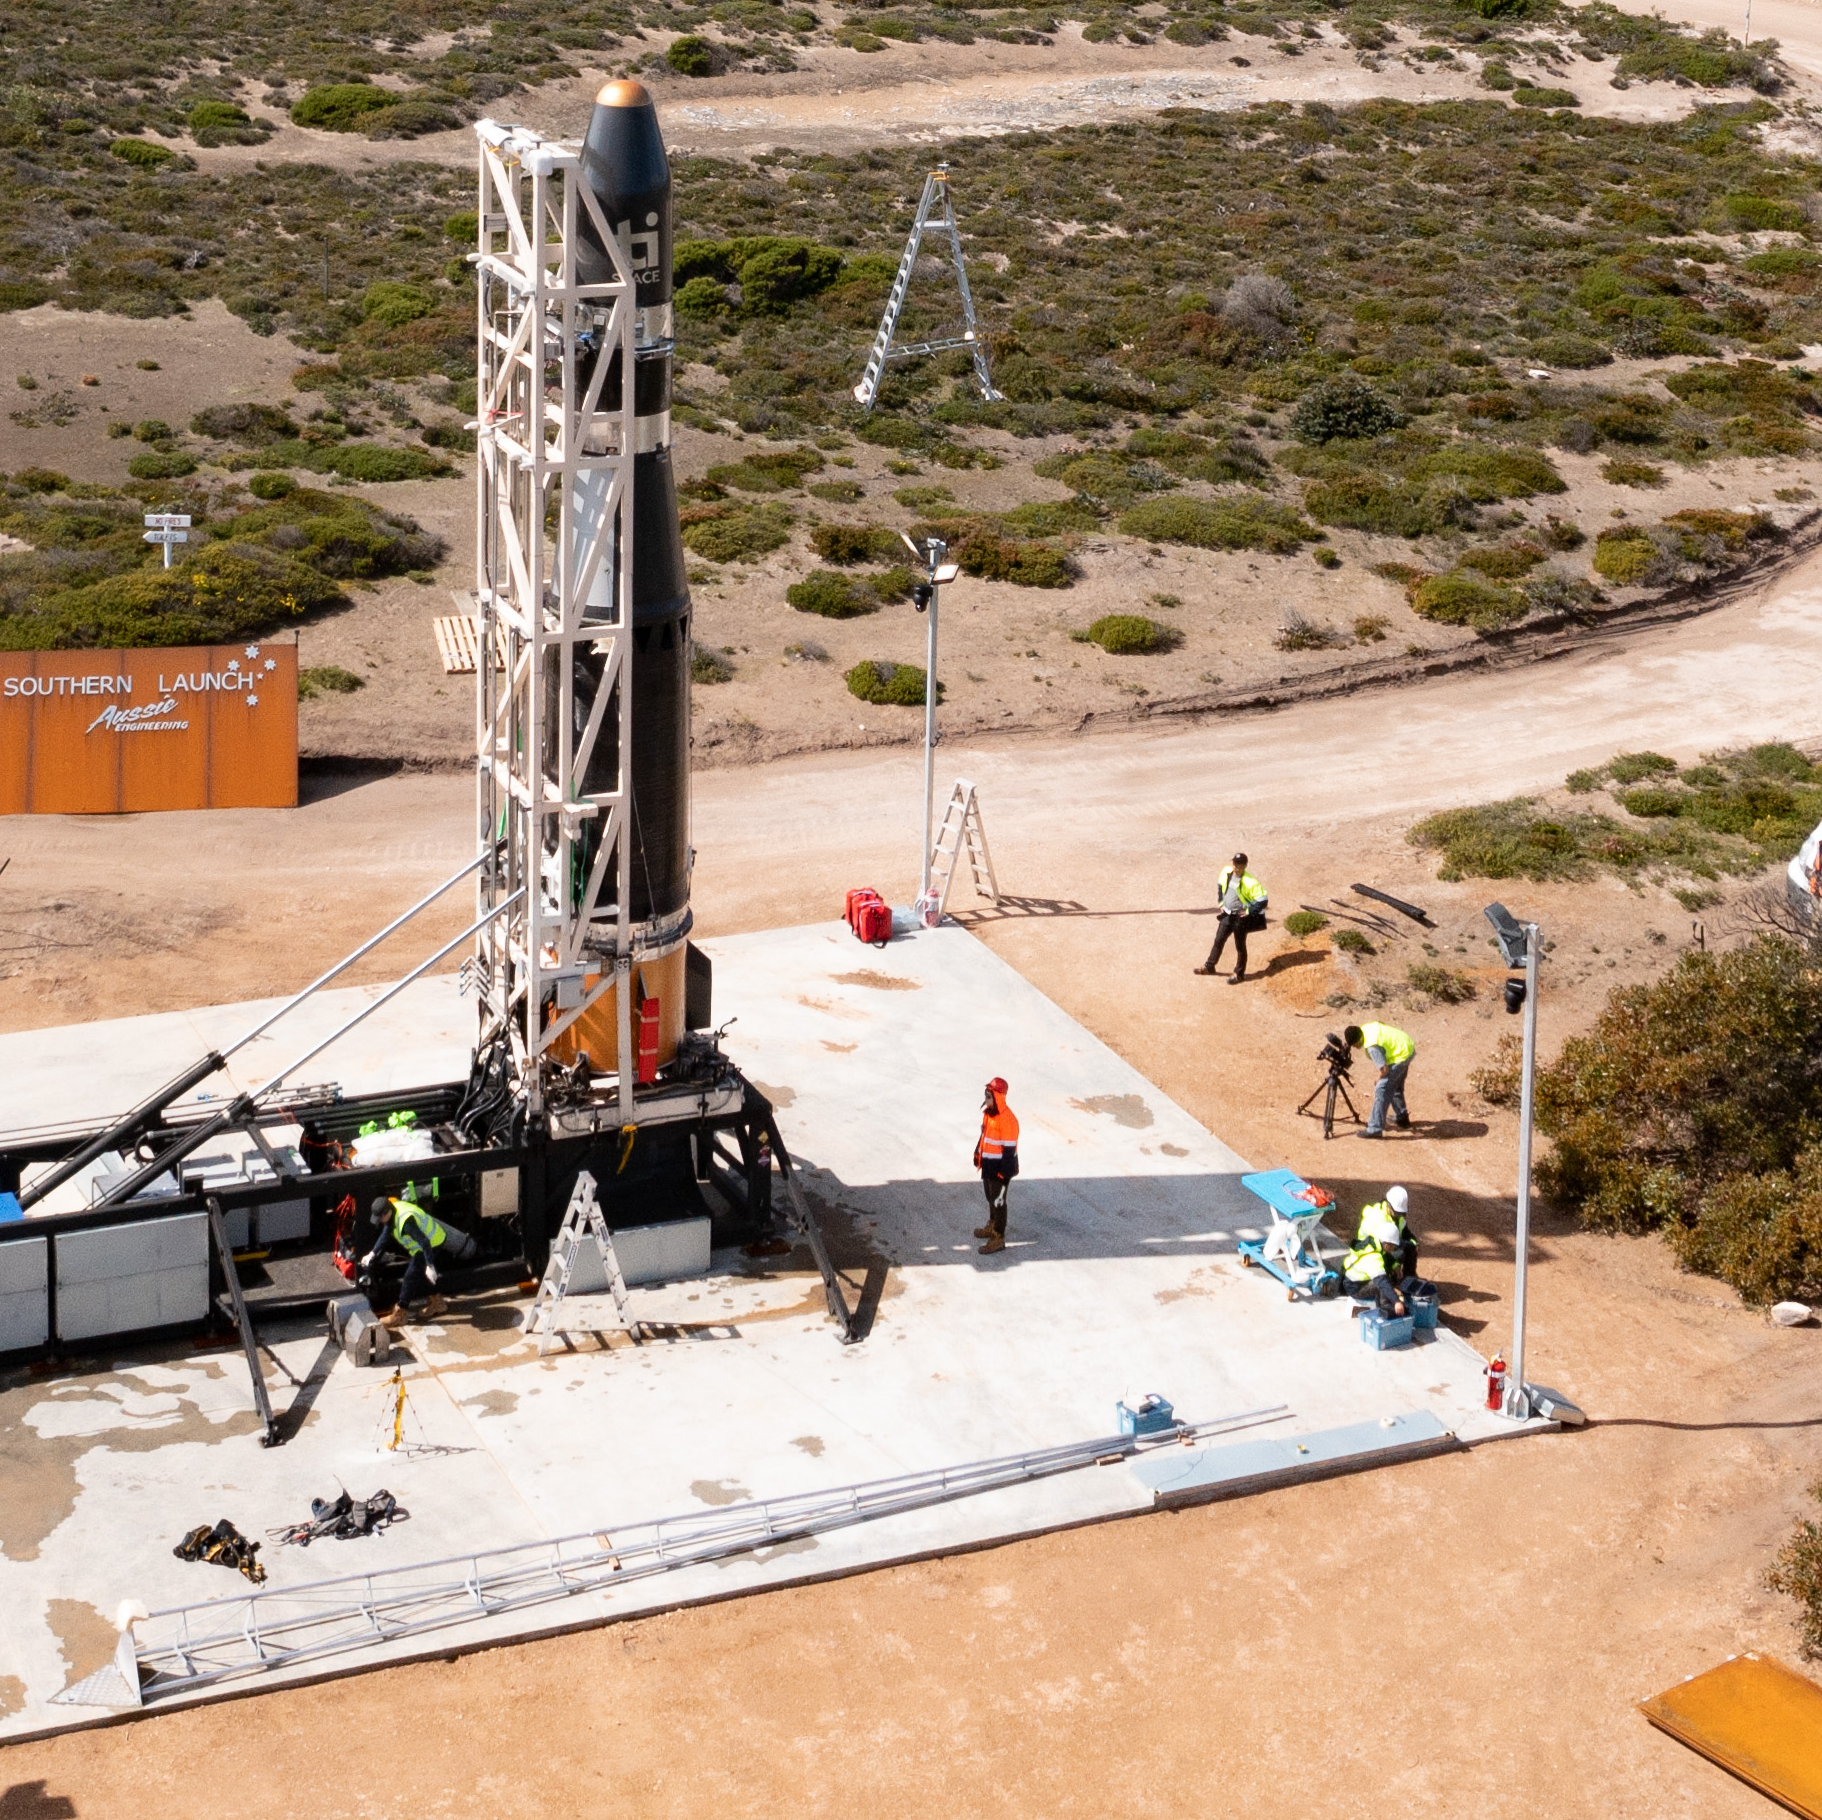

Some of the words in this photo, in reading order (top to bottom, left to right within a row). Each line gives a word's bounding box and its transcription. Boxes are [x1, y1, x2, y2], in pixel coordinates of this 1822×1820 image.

[612, 270, 660, 284] SACE
[3, 675, 132, 697] SOUTHERN
[158, 671, 254, 693] LAUNCH
[86, 694, 179, 734] Aussie
[114, 720, 189, 732] ENGINEERING
